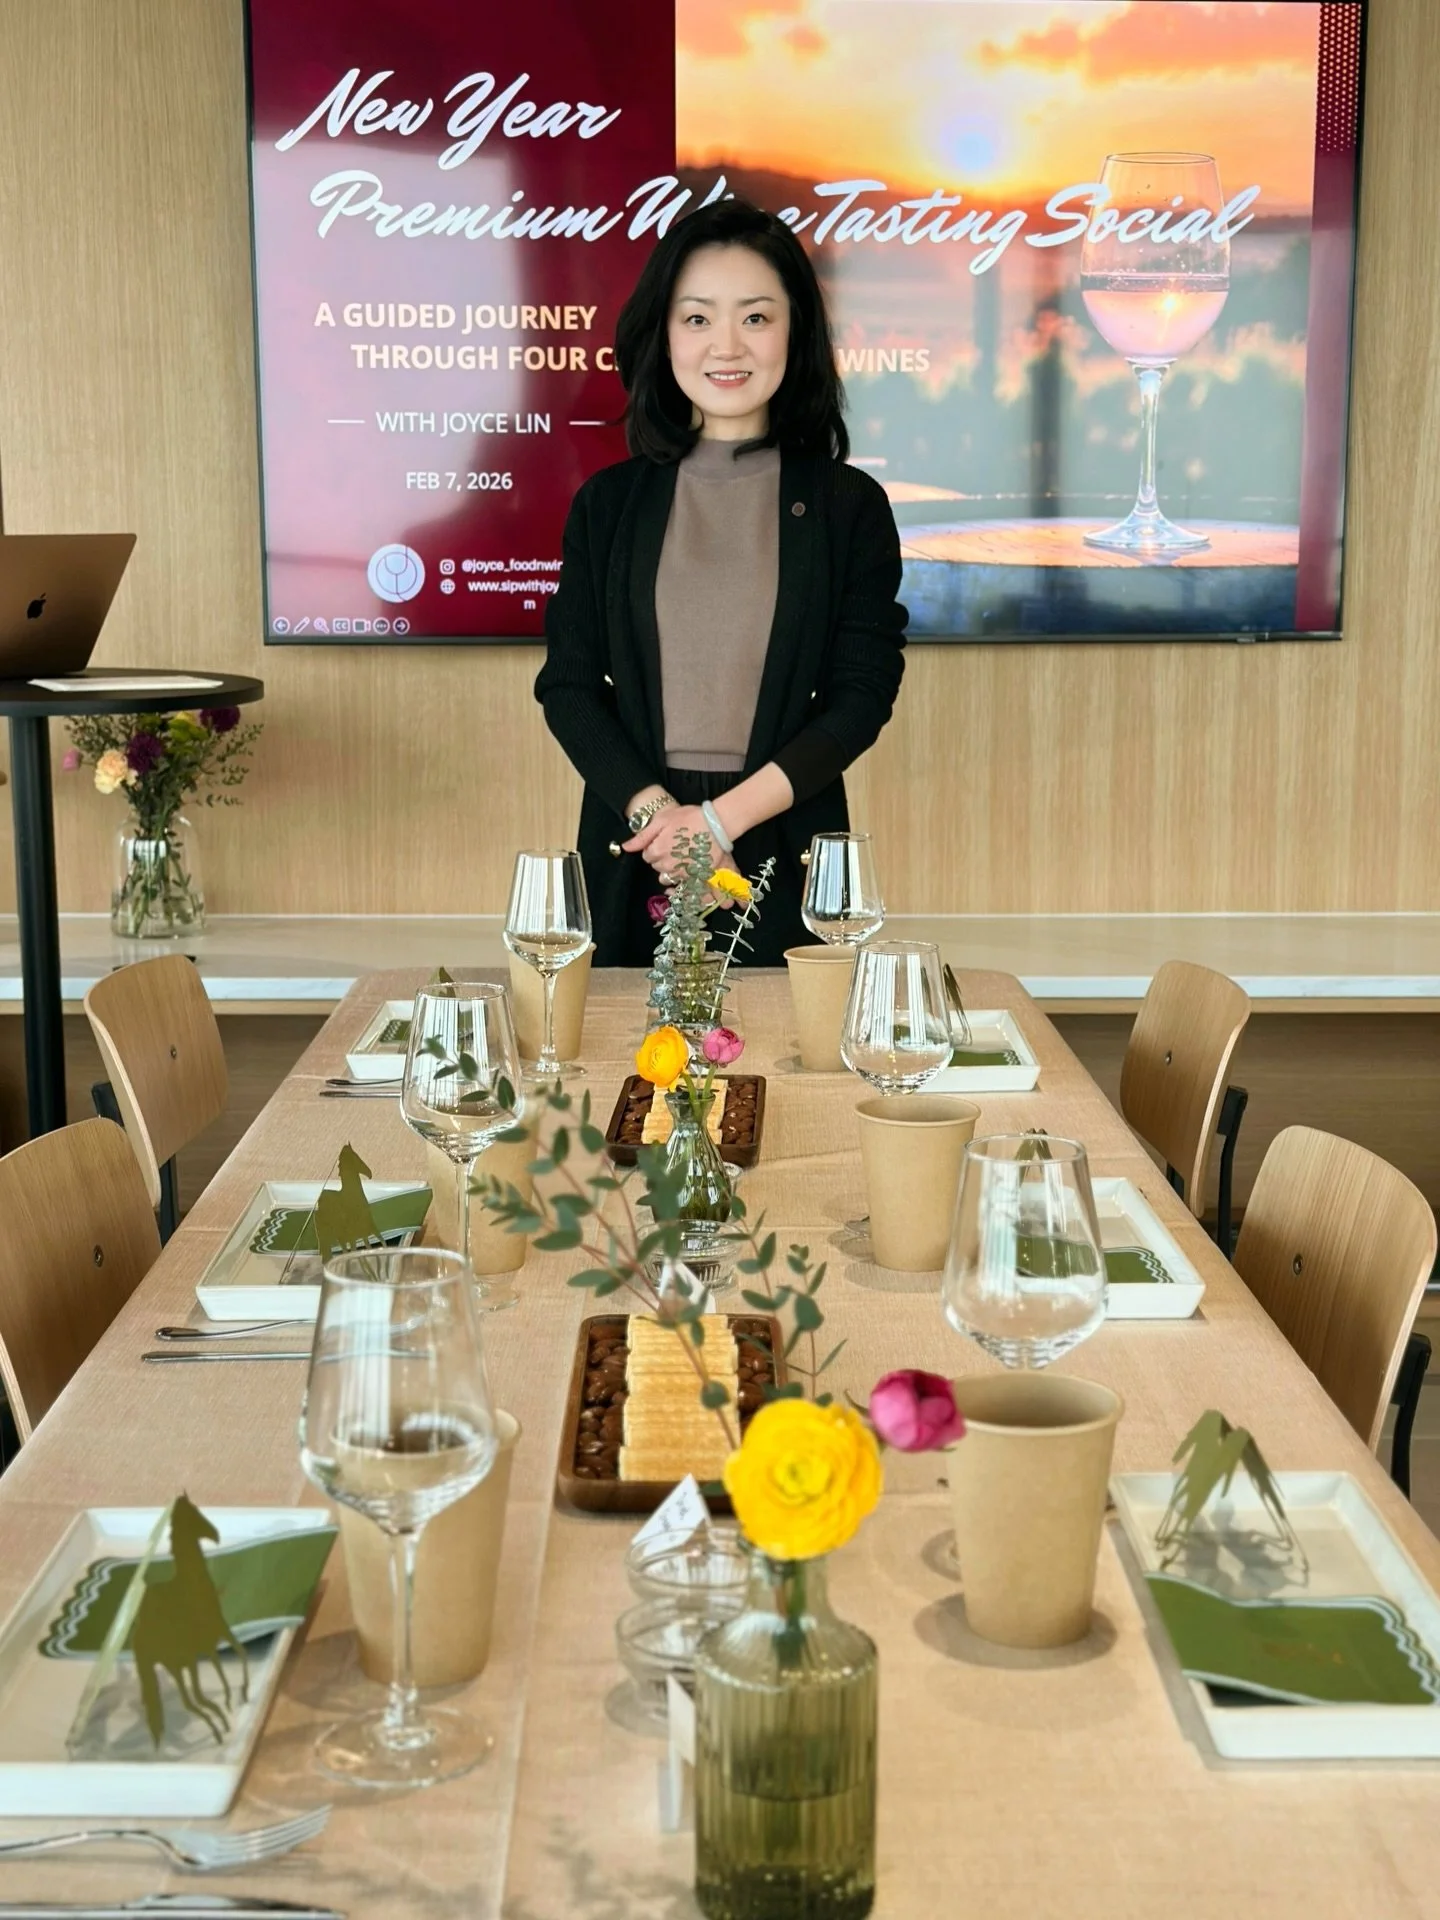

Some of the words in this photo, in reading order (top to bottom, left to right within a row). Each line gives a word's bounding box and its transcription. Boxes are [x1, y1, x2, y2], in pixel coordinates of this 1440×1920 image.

[275, 68, 433, 152] New
[438, 71, 621, 170] Year
[310, 169, 623, 242] Premium
[626, 175, 818, 241] We
[813, 179, 1028, 275] Tasting
[1025, 182, 1261, 249] Social
[314, 302, 336, 327] A
[343, 302, 456, 329] GUIDED
[462, 303, 598, 335] JOURNEY
[351, 344, 499, 371] THROUGH
[507, 345, 589, 371] FOUR
[838, 348, 930, 373] WINES
[375, 412, 436, 433] WITH
[440, 413, 508, 438] JOYCE
[515, 413, 551, 434] LIN
[406, 471, 440, 490] FEB
[445, 472, 462, 492] 7,
[466, 472, 513, 490] 2026
